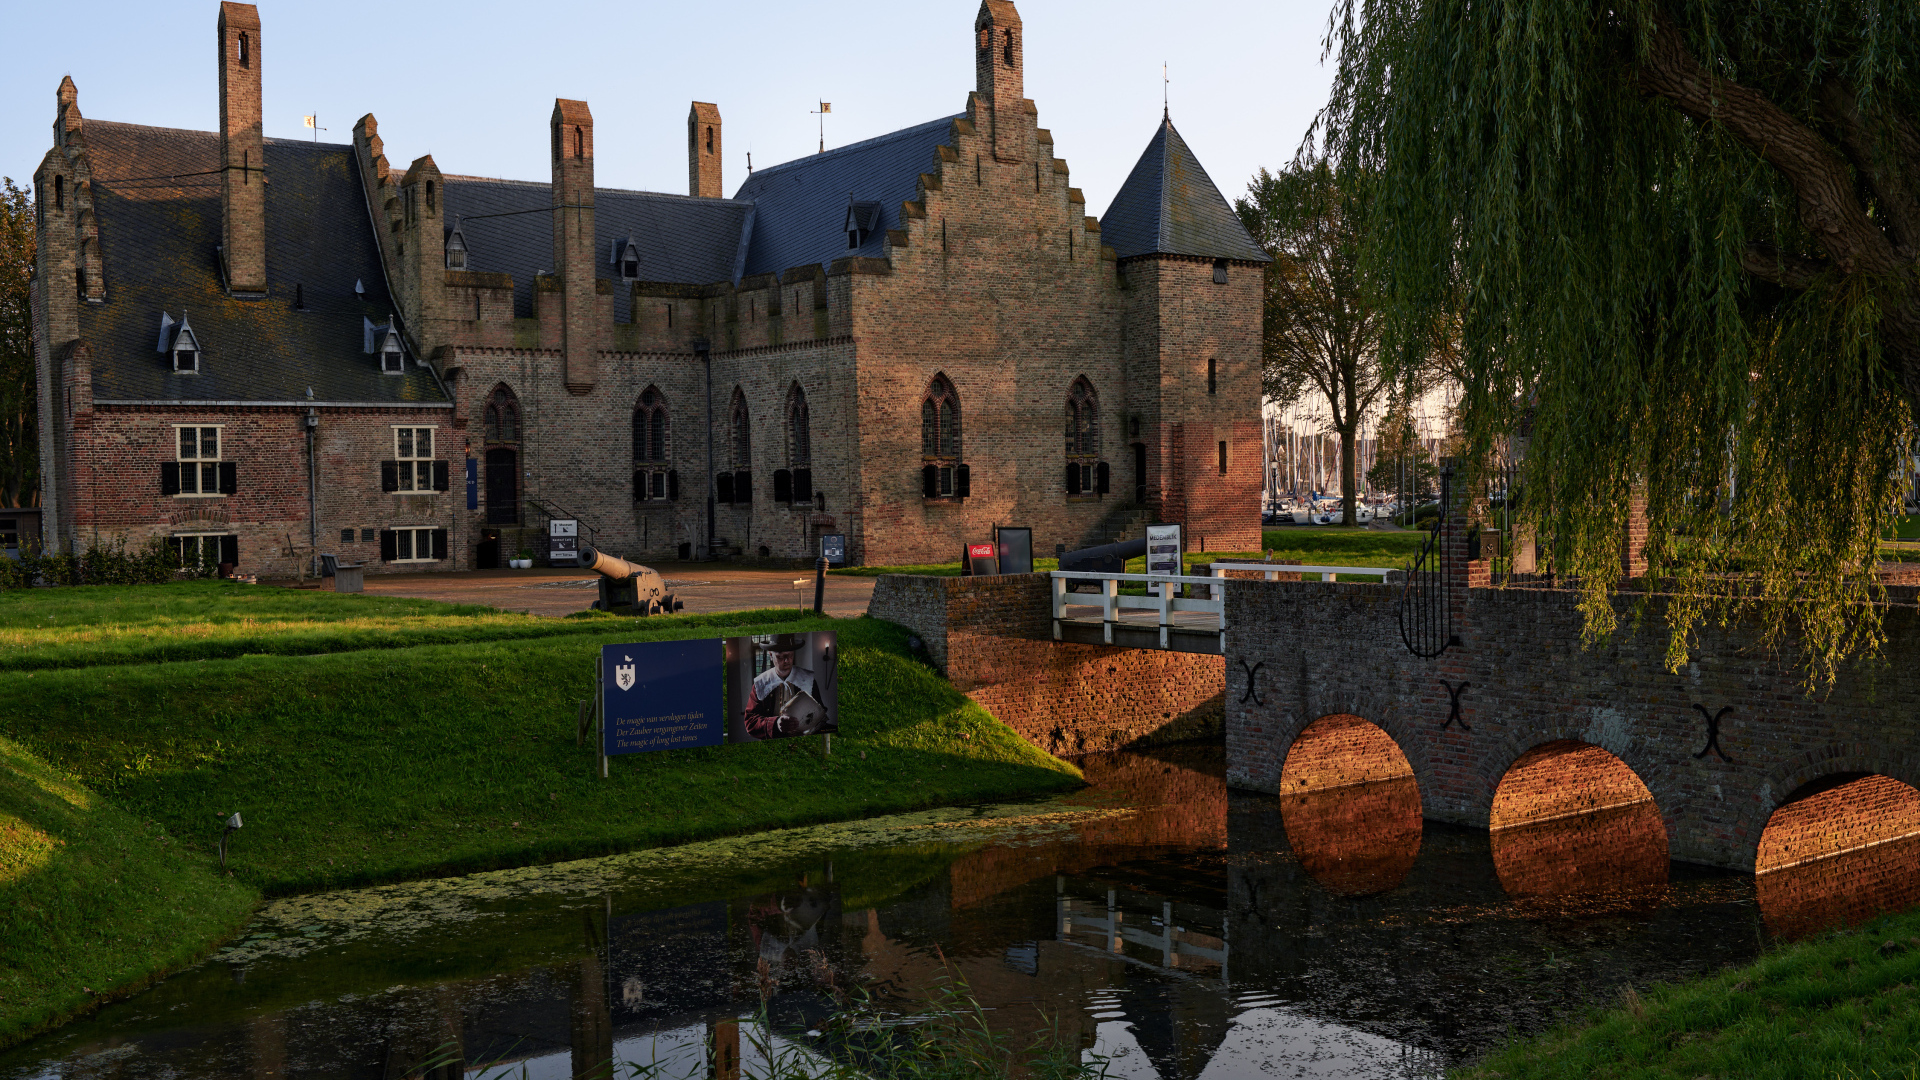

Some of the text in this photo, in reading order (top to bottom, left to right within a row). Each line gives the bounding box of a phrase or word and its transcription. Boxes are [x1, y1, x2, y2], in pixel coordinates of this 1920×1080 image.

[616, 717, 626, 726] De
[626, 716, 645, 727] magic
[659, 712, 687, 723] vervlogen
[687, 710, 704, 722] tijden
[616, 722, 708, 737] Der Zauber vergangener Zeiten
[616, 734, 698, 749] The magic of long lost times
